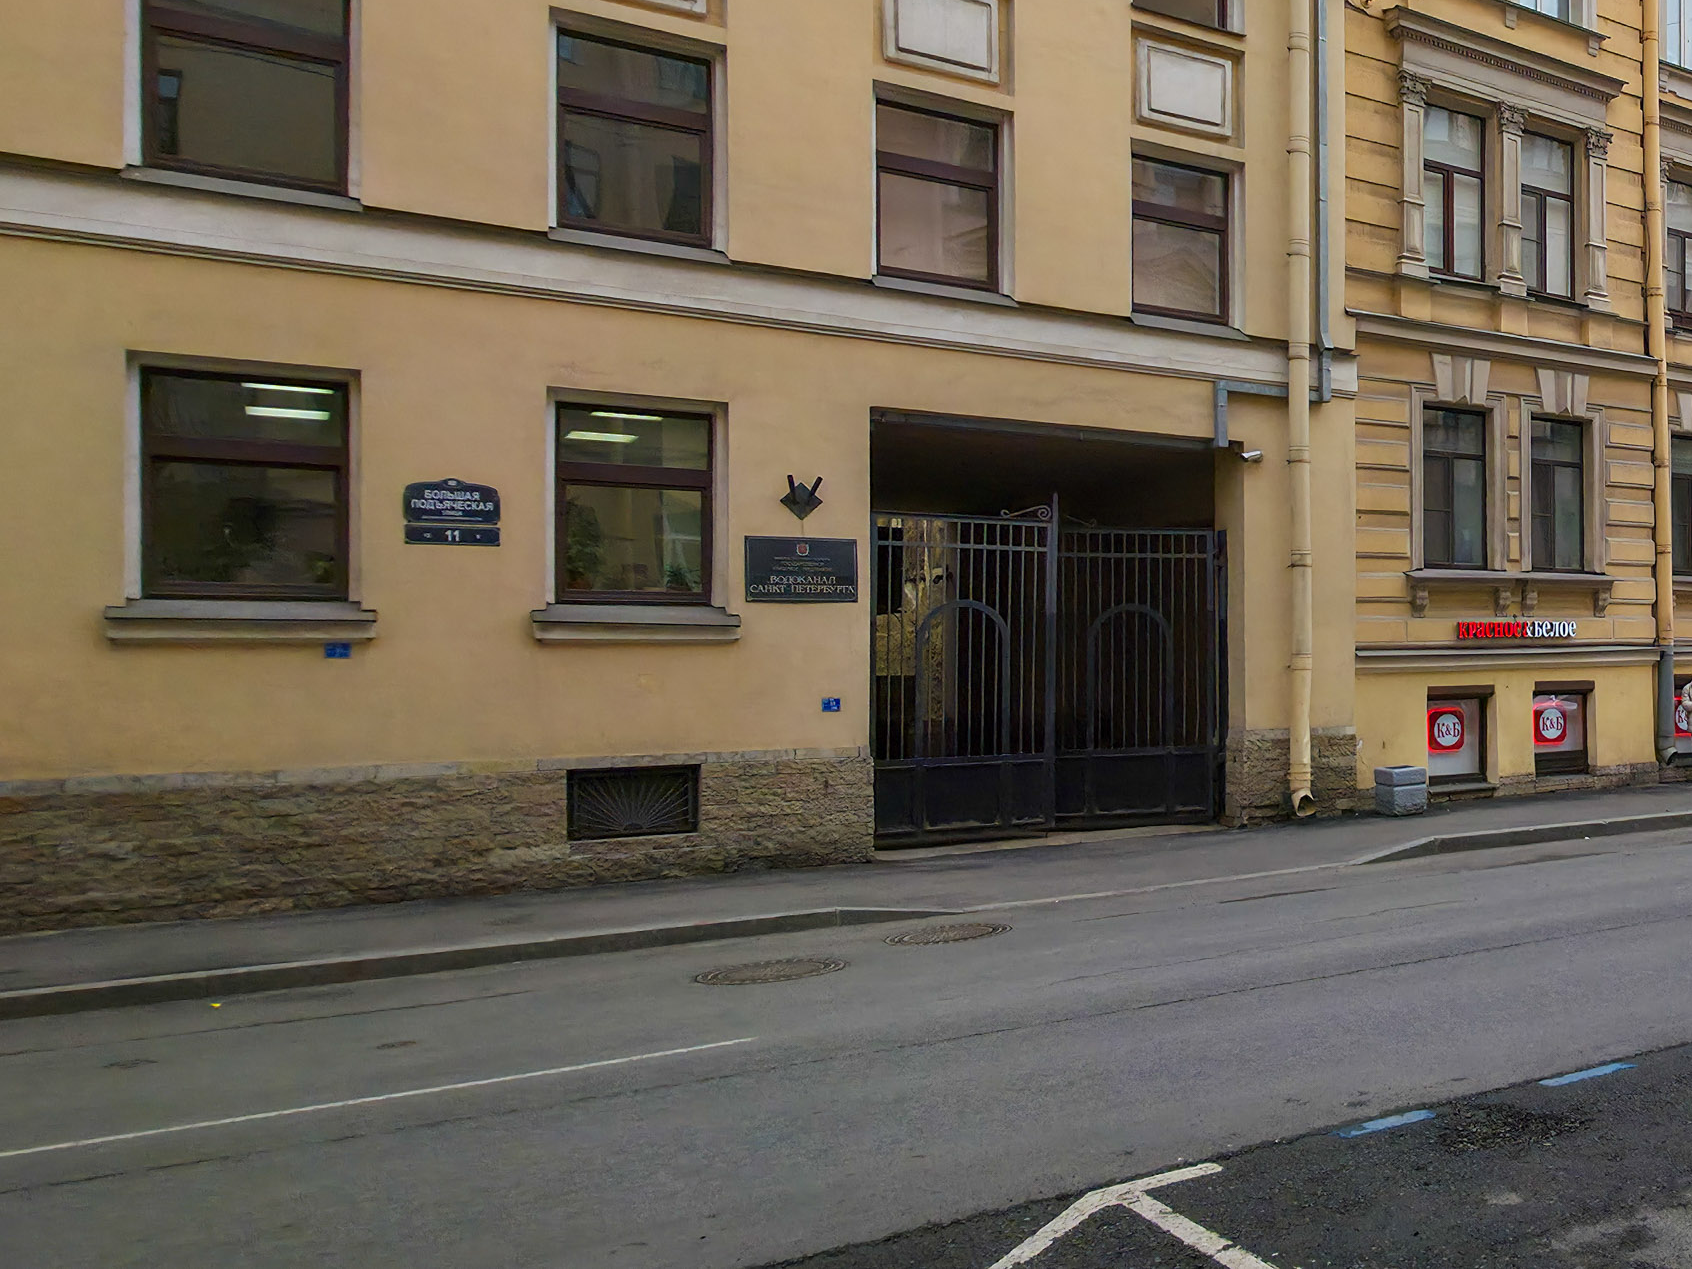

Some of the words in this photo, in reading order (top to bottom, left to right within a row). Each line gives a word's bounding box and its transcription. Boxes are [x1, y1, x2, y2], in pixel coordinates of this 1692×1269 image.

[424, 490, 480, 500] БОЛЬШАЯ
[411, 499, 494, 511] ПОДЪЯЧЕСКАЯ
[445, 530, 460, 541] 11
[1541, 716, 1563, 731] К&Б
[1437, 722, 1461, 738] К&Б
